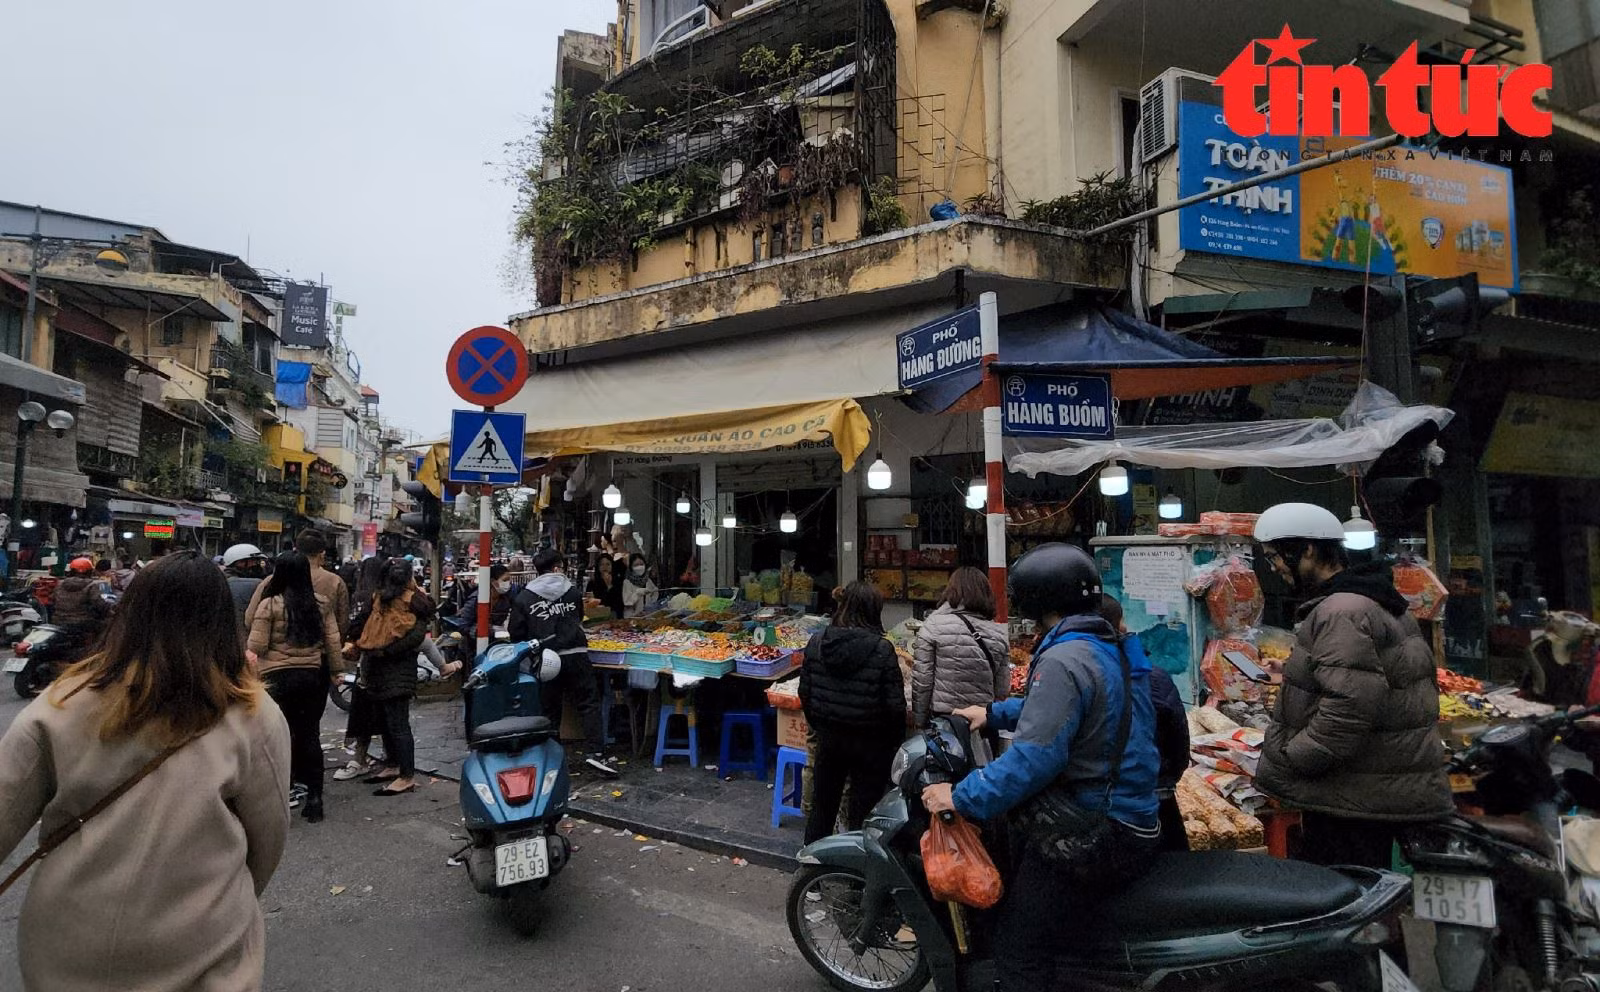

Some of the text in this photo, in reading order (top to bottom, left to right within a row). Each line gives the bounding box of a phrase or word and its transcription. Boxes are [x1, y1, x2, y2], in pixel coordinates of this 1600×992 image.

[1205, 138, 1289, 174] TOÀN
[1203, 177, 1293, 214] THỊNH
[291, 315, 318, 326] Music
[295, 325, 313, 334] Café
[932, 321, 959, 344] PHỐ
[902, 336, 982, 381] HÀNG ĐƯỜNG
[1047, 381, 1079, 397] PHỐ
[1007, 396, 1106, 427] HÀNG BUỒM
[760, 424, 797, 438] CAO
[503, 842, 540, 864] 29-E2
[500, 858, 545, 884] 756.93
[1422, 876, 1481, 900] 29-T7
[1424, 898, 1482, 923] 1051
